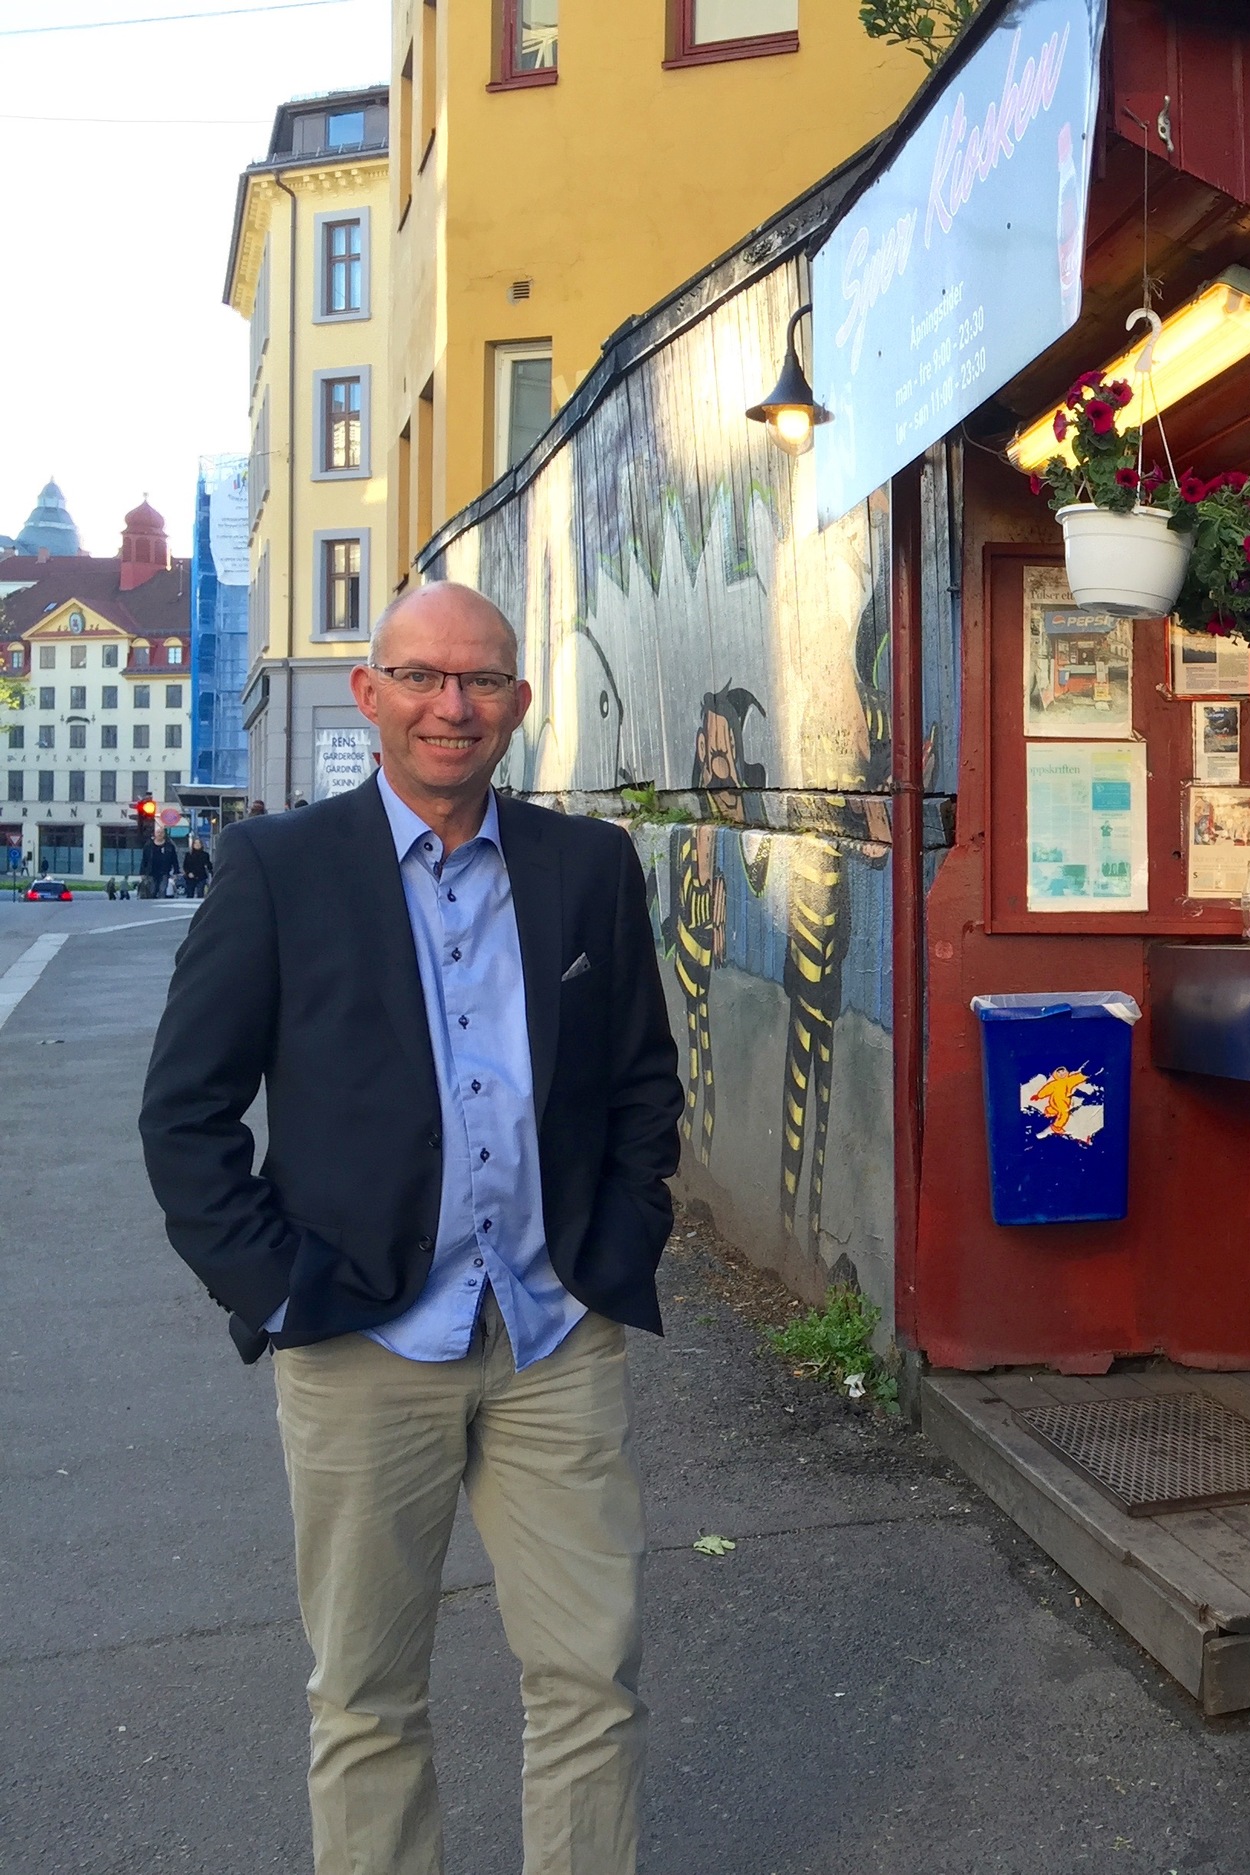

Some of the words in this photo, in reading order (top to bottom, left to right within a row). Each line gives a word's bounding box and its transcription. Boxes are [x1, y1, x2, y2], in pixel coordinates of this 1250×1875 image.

[924, 21, 1070, 249] Kiosken
[910, 281, 964, 350] Åpningstider
[896, 379, 913, 408] man
[919, 361, 932, 387] fre
[933, 337, 951, 375] 9:00
[959, 305, 984, 350] 23:30
[931, 376, 953, 417] 11:00
[960, 346, 986, 390] 23:30
[1067, 615, 1110, 627] PEPSI
[332, 737, 356, 748] RENS
[323, 752, 365, 761] GARDEROBE
[326, 765, 362, 774] GARDINER
[332, 778, 355, 787] SKINN
